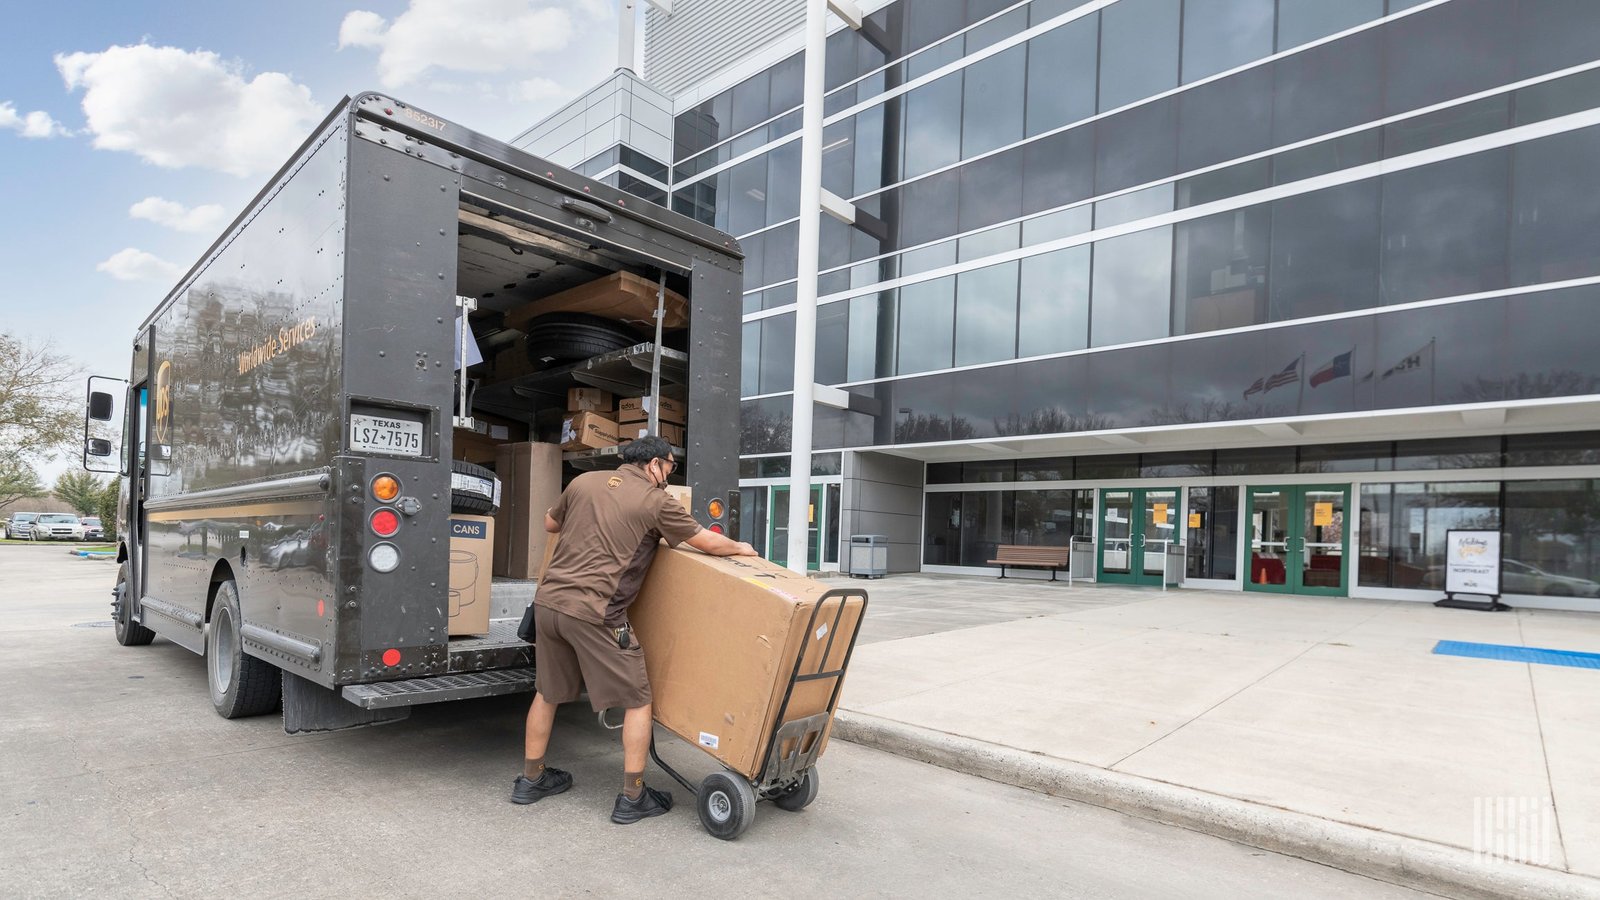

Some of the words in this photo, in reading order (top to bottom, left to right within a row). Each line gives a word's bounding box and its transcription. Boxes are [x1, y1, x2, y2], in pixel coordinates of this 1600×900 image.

[238, 334, 277, 375] Worldwide
[279, 315, 316, 354] Services
[372, 419, 401, 429] TEXAS
[453, 524, 480, 535] CANS
